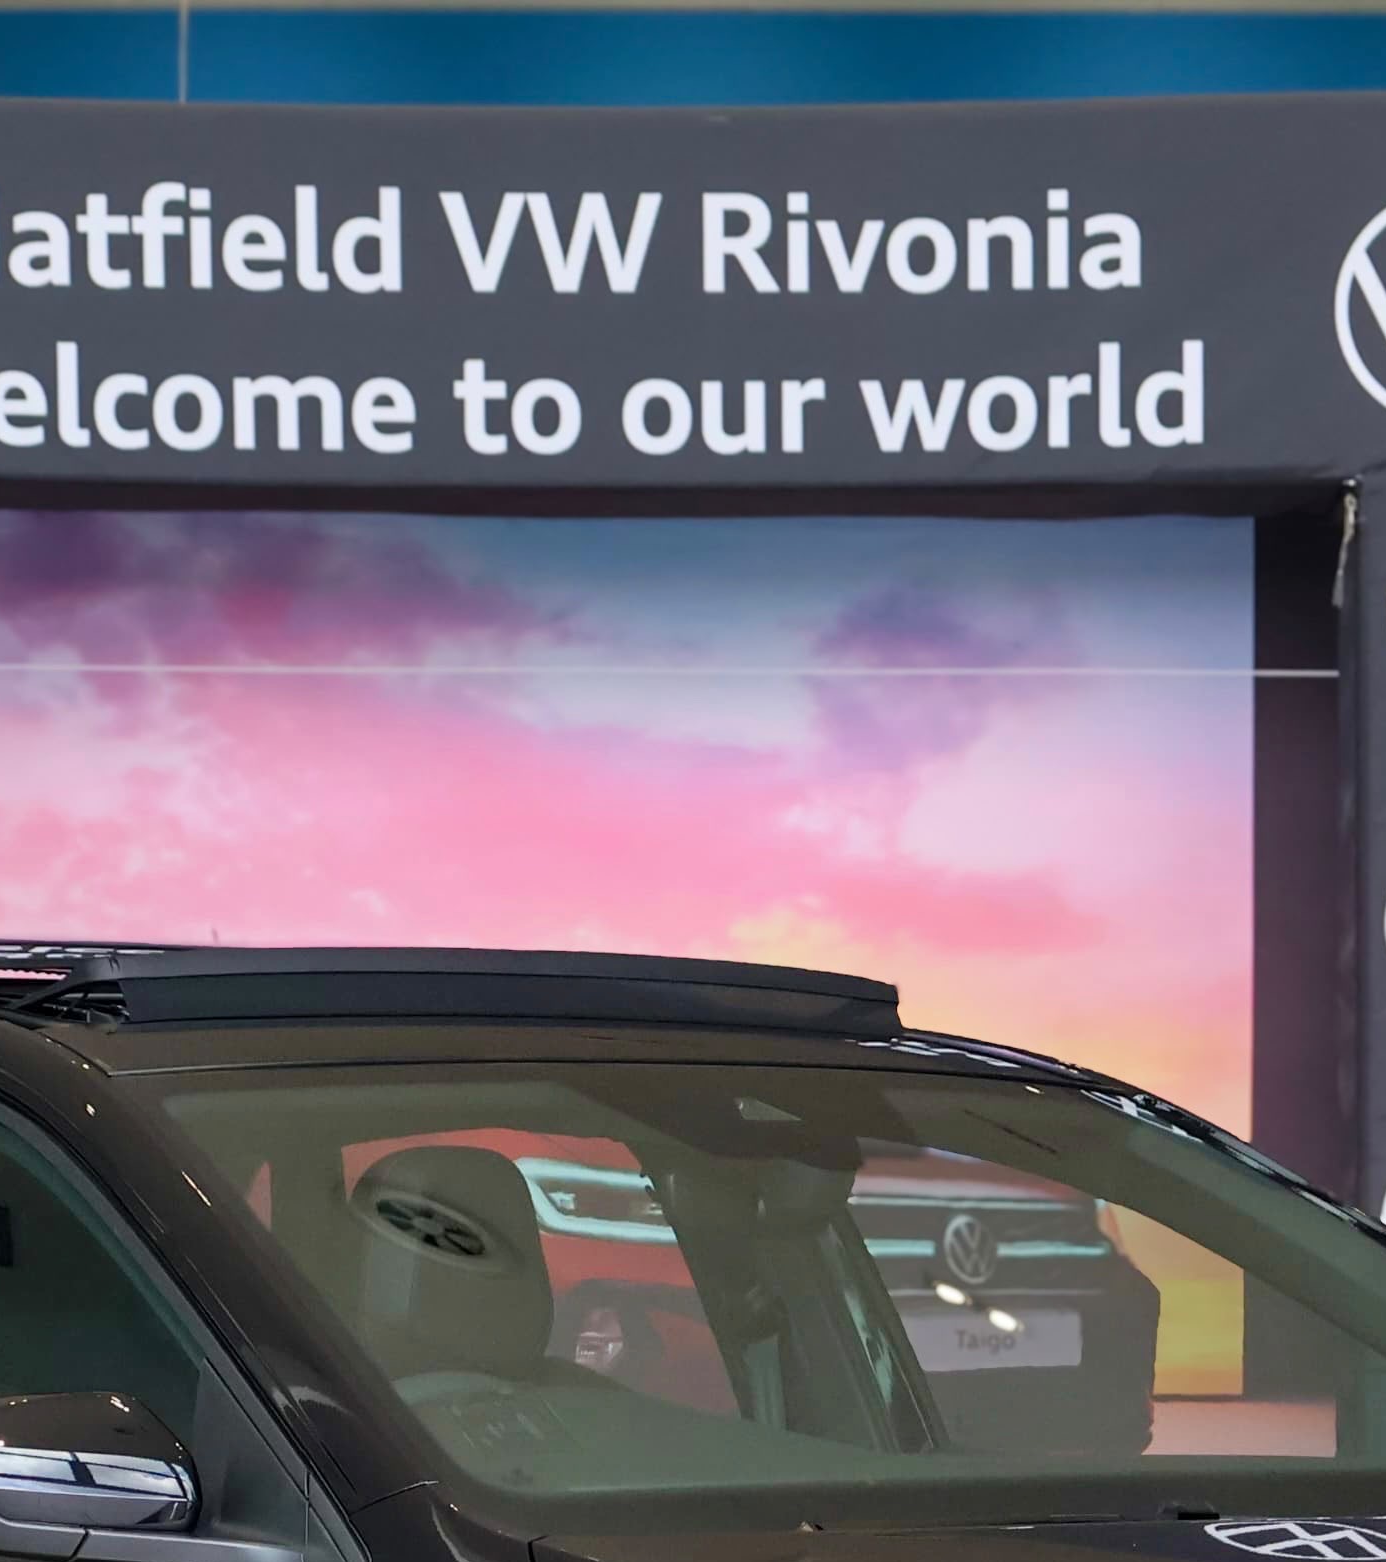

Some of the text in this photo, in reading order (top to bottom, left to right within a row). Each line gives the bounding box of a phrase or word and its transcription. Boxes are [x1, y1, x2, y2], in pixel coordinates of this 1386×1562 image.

[440, 191, 661, 293] VW
[703, 189, 1141, 294] Rivonia
[454, 359, 582, 455] to
[623, 379, 826, 455] our
[860, 340, 1204, 453] world
[955, 1328, 1018, 1355] Taigo
